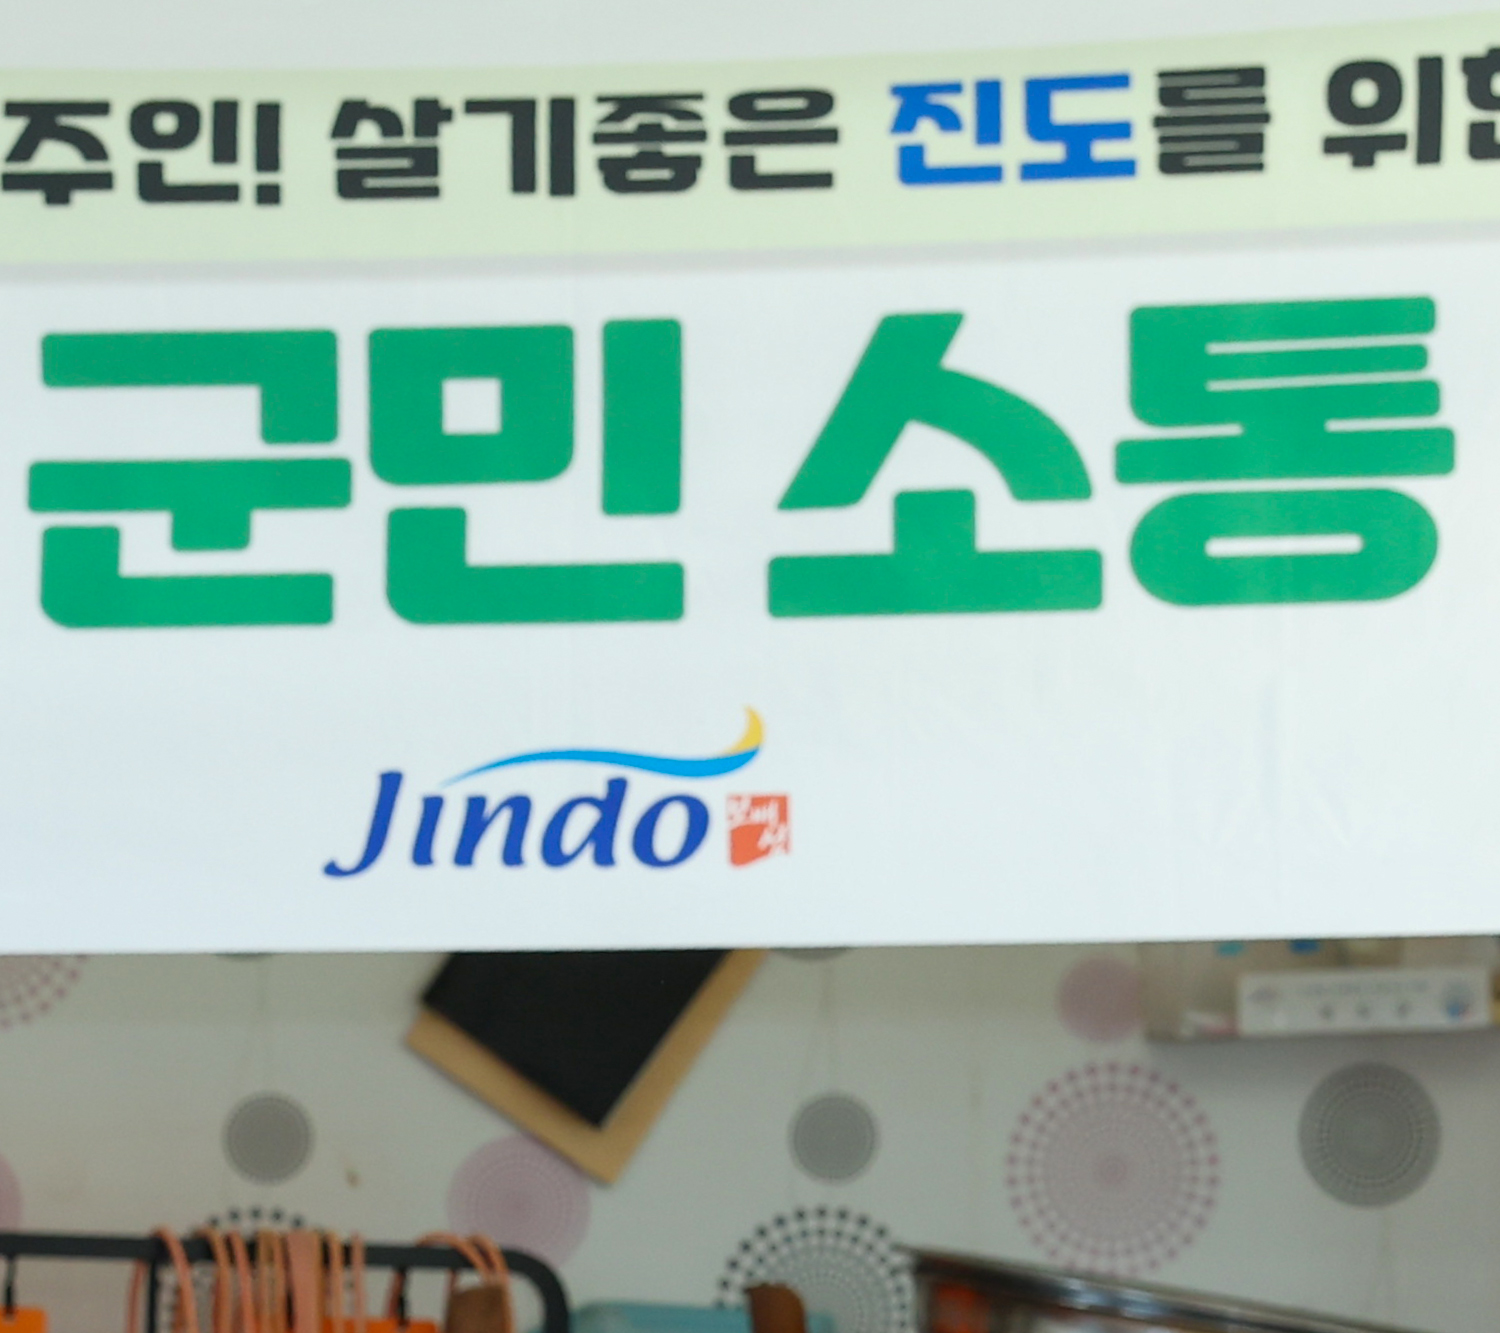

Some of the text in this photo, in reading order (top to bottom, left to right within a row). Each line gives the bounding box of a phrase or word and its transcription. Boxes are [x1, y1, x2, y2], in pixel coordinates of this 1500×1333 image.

[328, 86, 840, 201] 살기좋은
[889, 64, 1272, 187] 진도를
[26, 317, 686, 630] 군민
[766, 294, 1456, 619] 소통
[322, 770, 710, 878] Jindo
